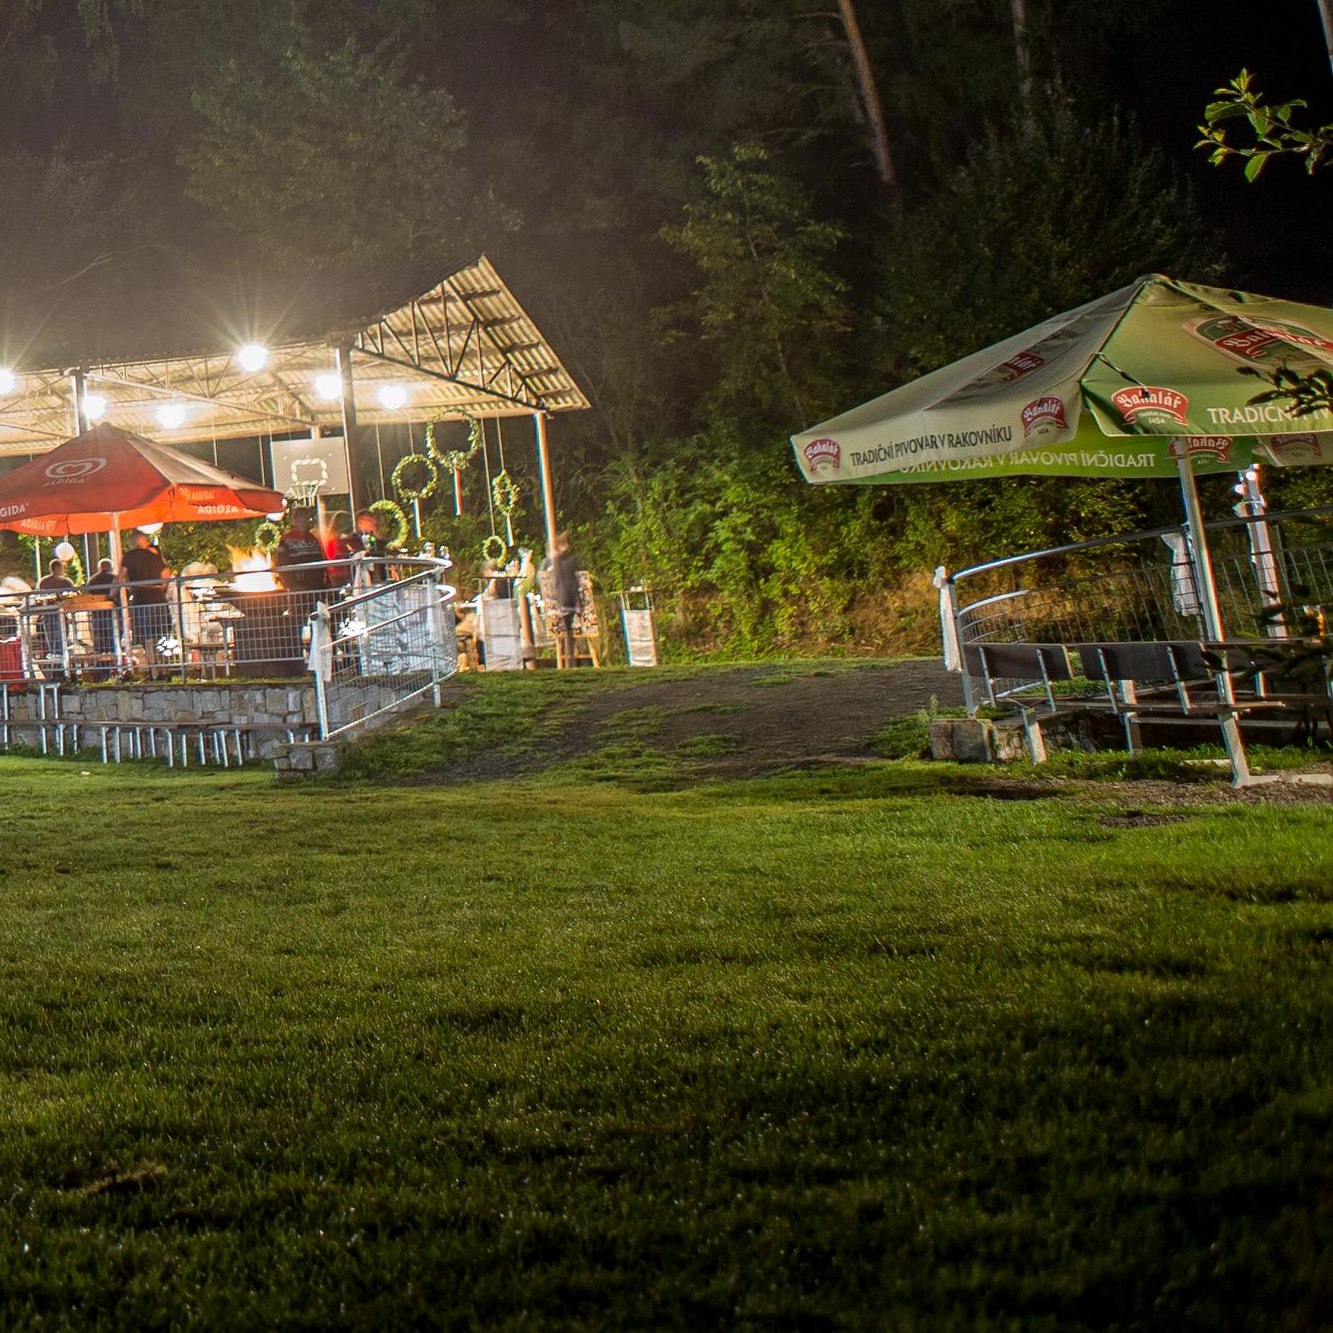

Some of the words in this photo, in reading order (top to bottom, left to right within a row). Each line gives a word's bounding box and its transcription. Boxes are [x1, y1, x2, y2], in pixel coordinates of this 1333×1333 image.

[1206, 401, 1299, 424] TRADIČN
[850, 441, 894, 467] TRADIČNÍ
[895, 434, 937, 458] PIVOVAR
[939, 434, 946, 448] V
[947, 424, 1013, 448] RAKOVNÍKU
